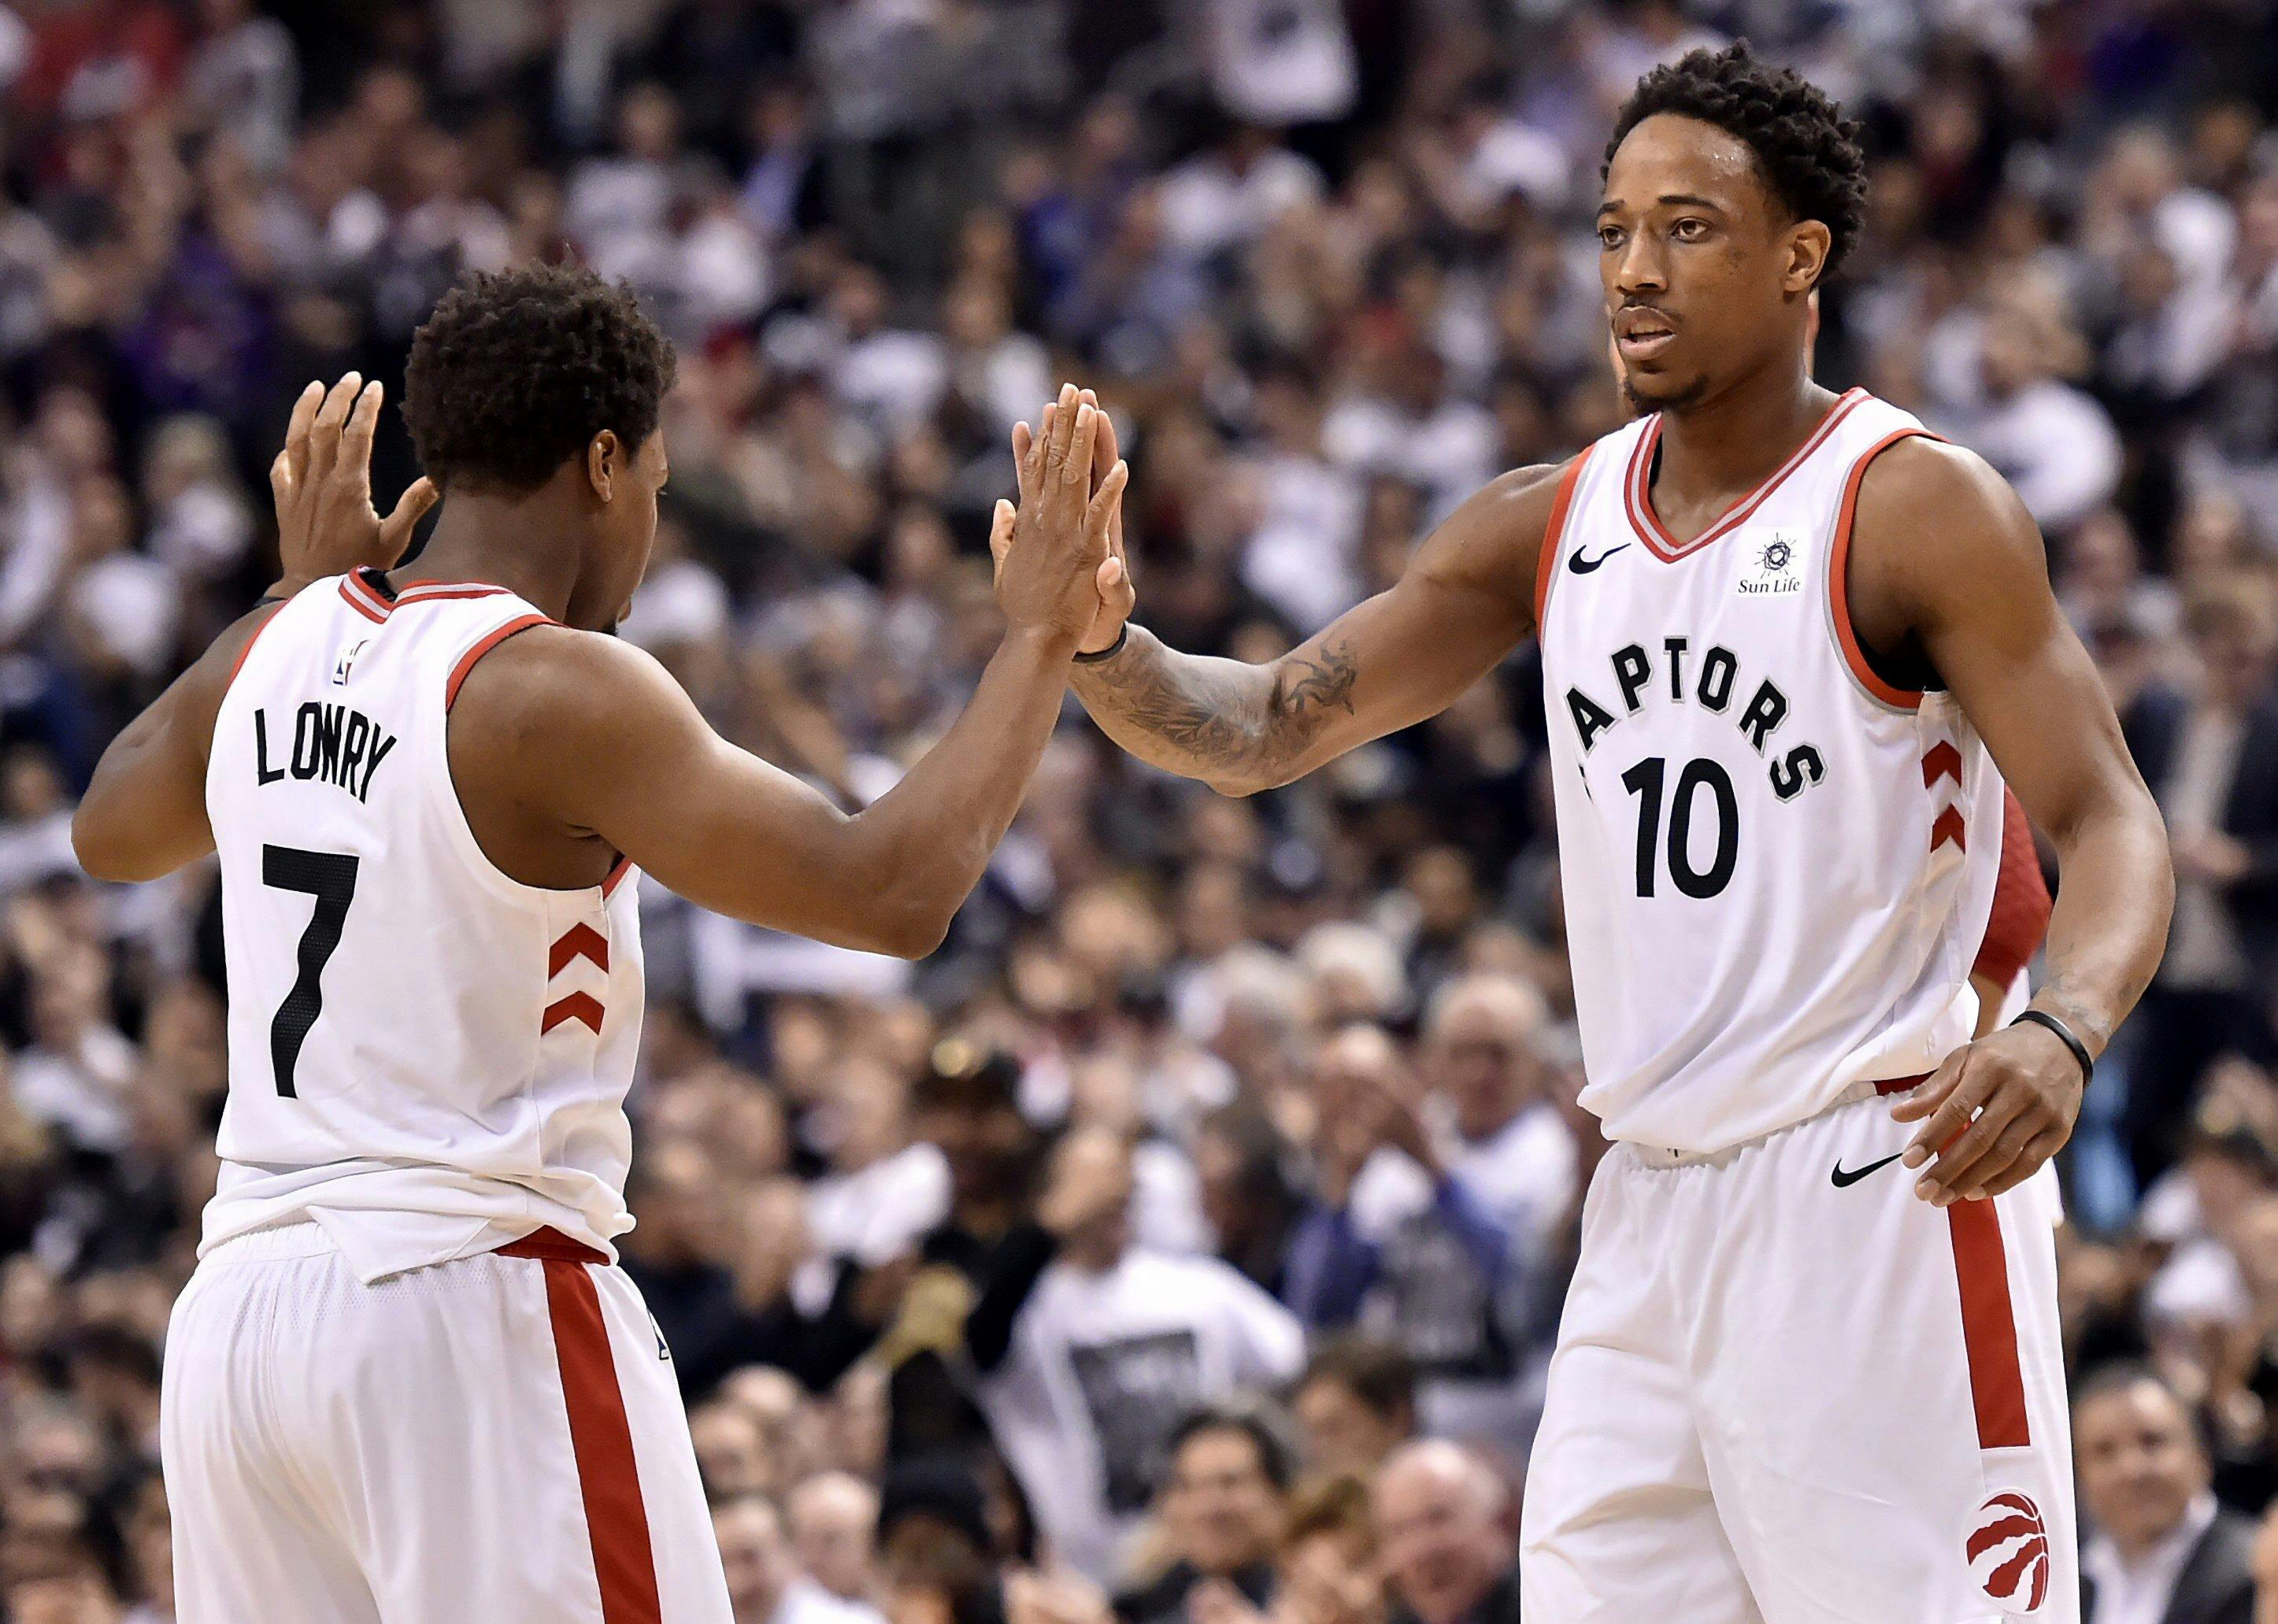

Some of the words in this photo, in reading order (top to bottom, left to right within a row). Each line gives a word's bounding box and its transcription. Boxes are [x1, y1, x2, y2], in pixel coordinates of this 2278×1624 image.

[1738, 579, 1769, 594] Sun
[1773, 576, 1800, 593] Life
[254, 701, 397, 805] LOWRY
[1564, 634, 1828, 805] APTORS
[1621, 757, 1740, 899] 10
[261, 843, 360, 1100] 7
